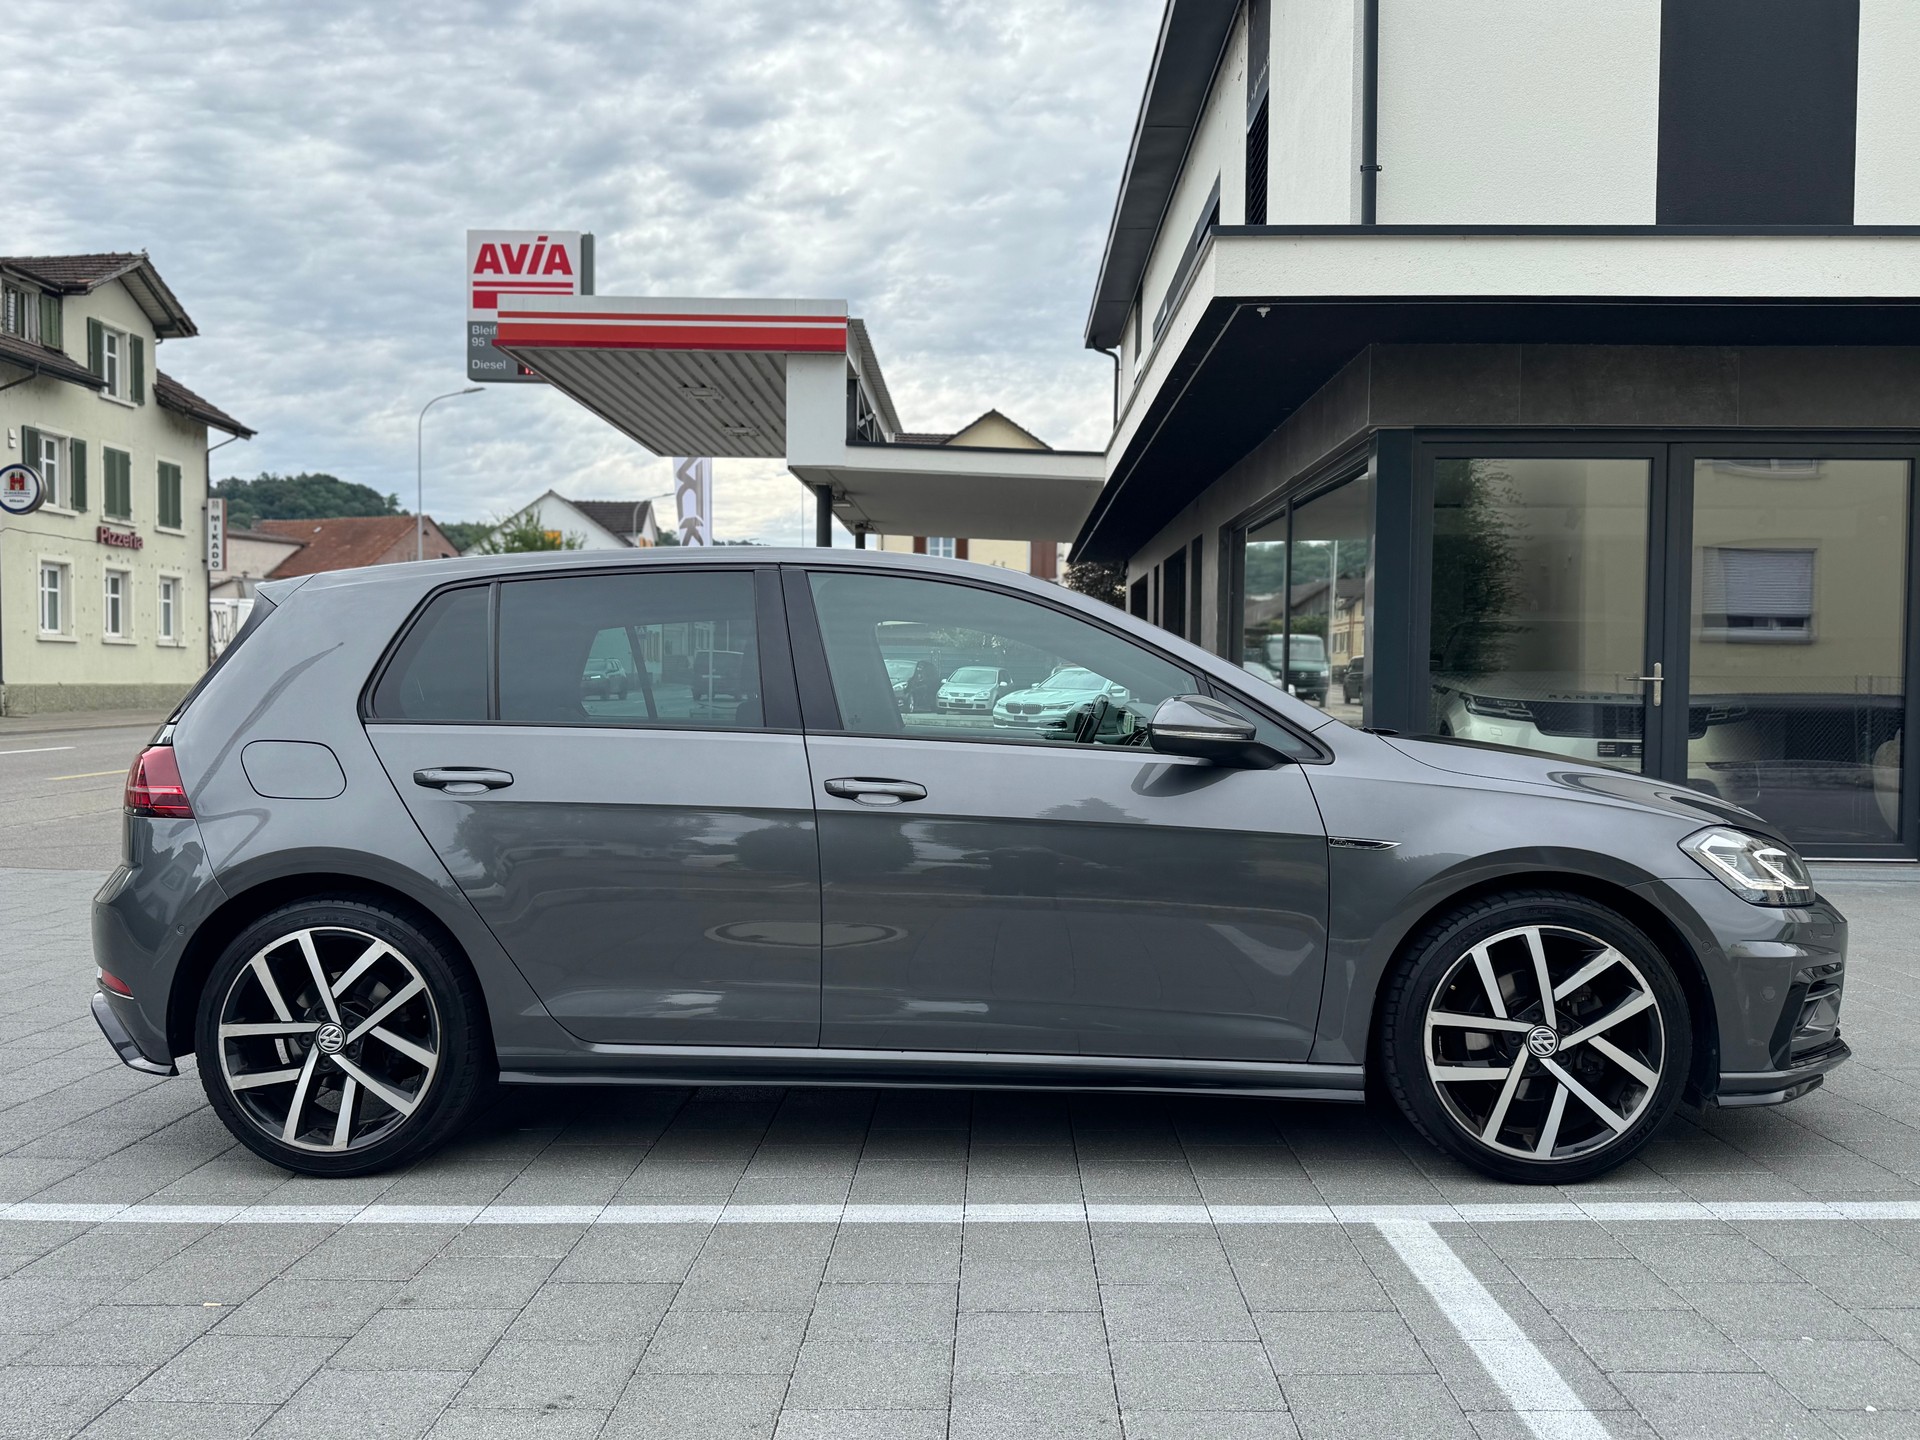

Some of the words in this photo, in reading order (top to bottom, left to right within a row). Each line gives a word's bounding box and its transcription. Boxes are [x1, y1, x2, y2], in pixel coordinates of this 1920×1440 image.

[472, 325, 498, 335] Bleif
[471, 337, 485, 347] 95
[472, 360, 506, 370] Diesel
[100, 527, 144, 549] Pizzeria
[210, 515, 220, 568] MIKADO
